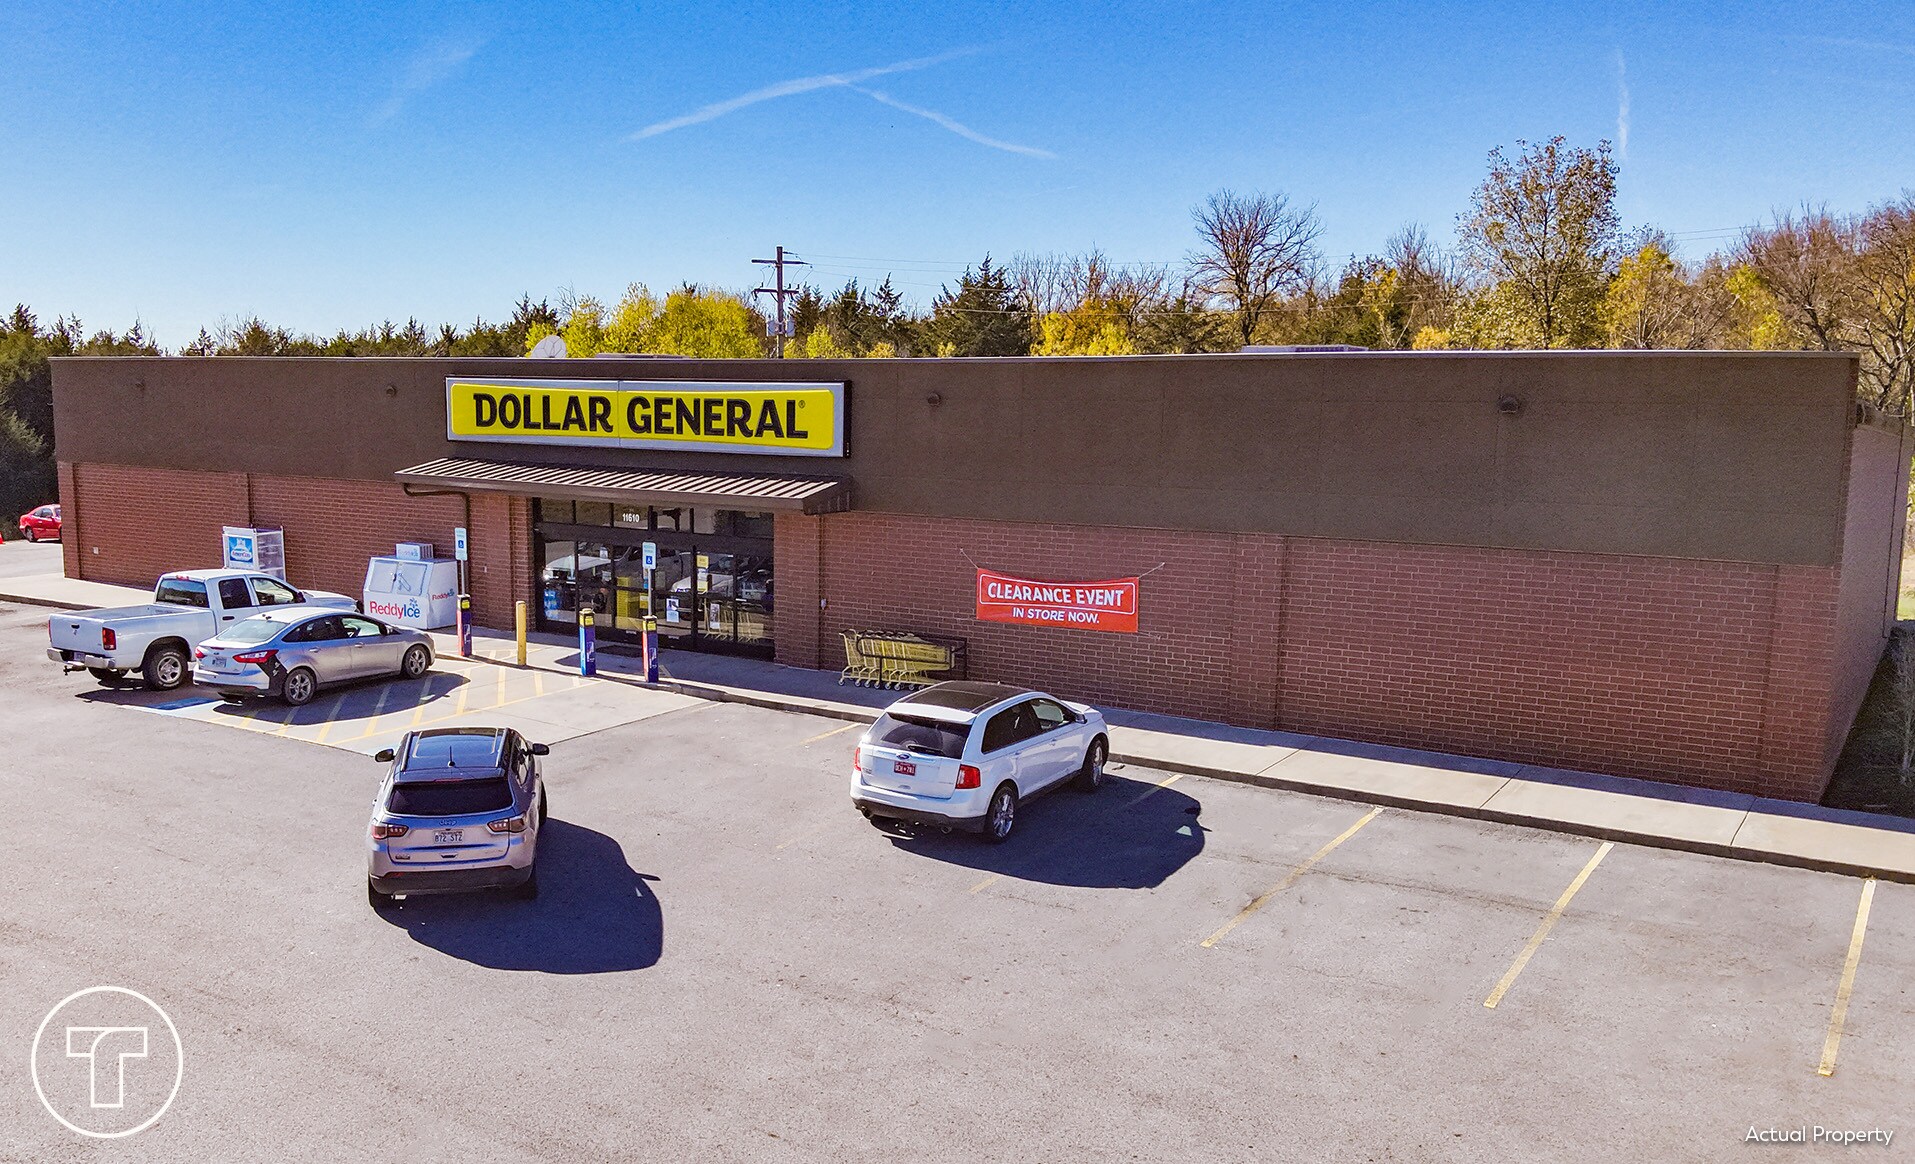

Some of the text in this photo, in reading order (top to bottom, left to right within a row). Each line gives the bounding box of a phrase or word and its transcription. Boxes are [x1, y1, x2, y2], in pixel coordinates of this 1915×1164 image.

[473, 393, 613, 433] DOLLAR
[622, 512, 640, 523] 11610
[987, 582, 1125, 607] CLEARANCE EVENT
[1012, 607, 1100, 624] IN STORE NOW.
